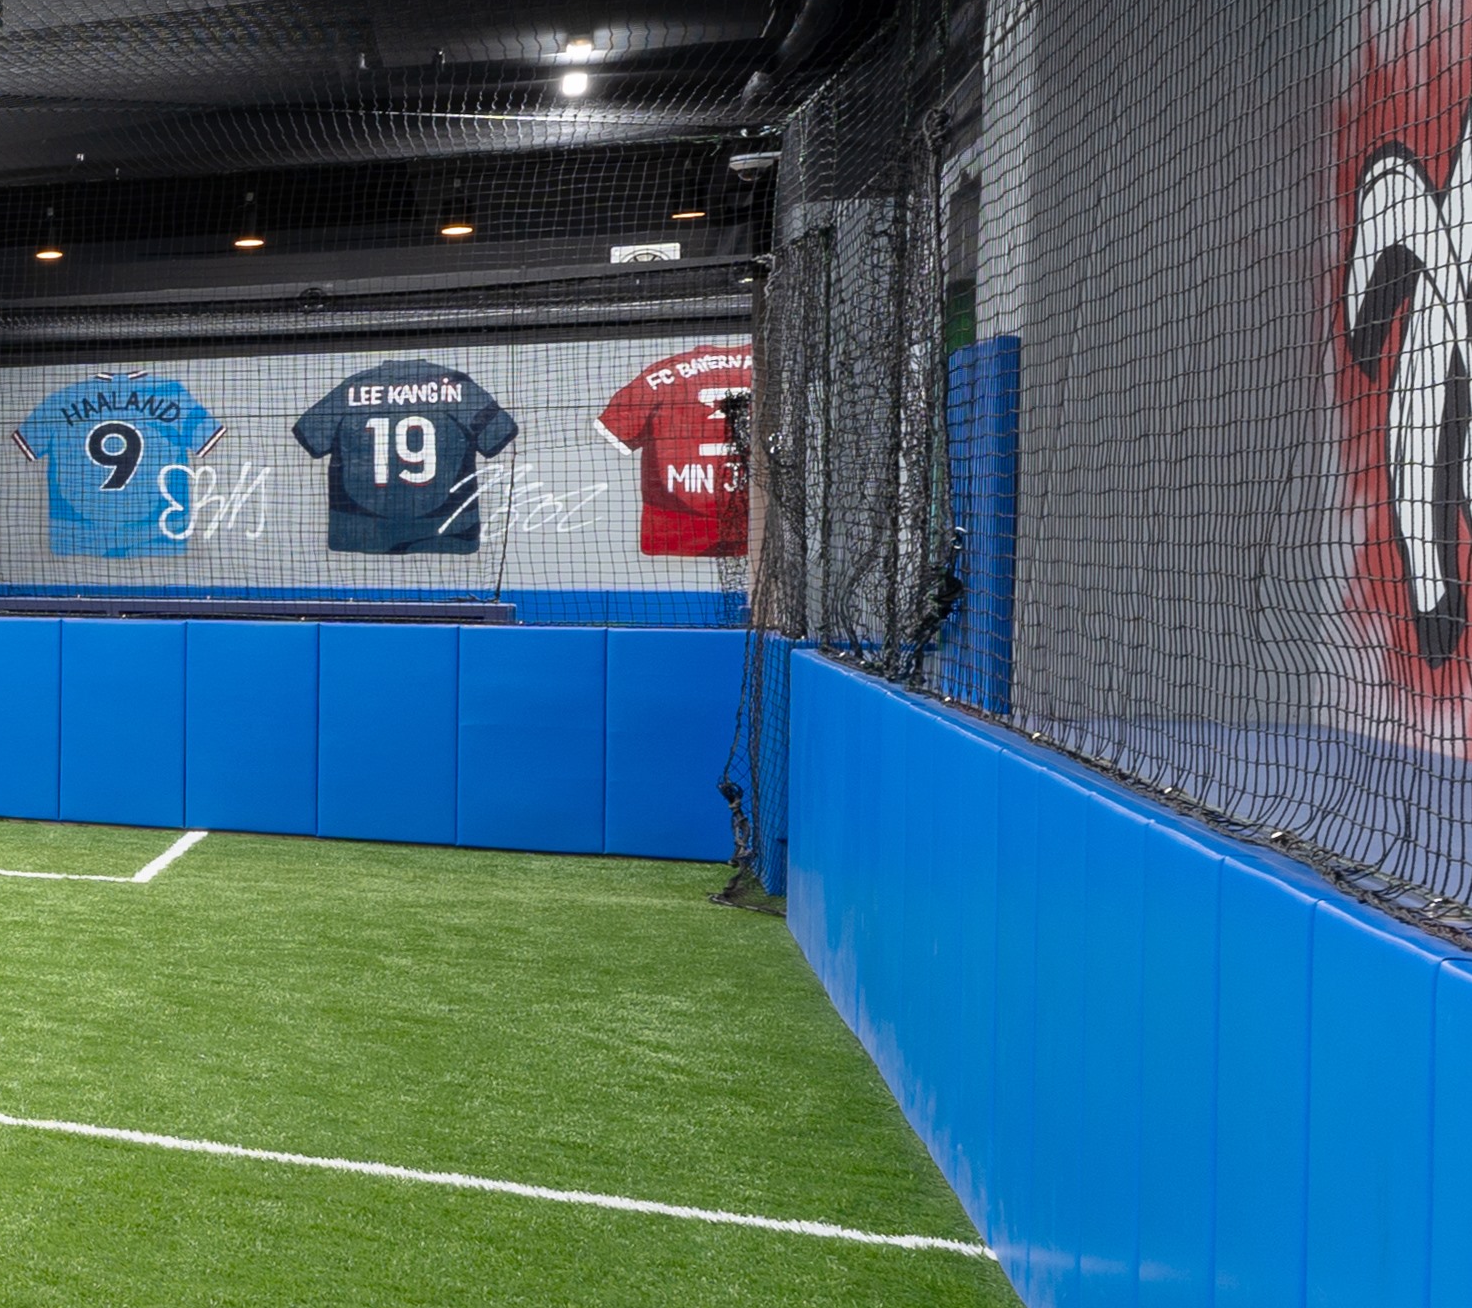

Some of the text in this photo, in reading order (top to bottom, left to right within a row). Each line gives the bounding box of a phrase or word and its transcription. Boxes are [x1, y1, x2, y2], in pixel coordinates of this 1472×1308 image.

[348, 386, 382, 406] LEE
[646, 369, 675, 390] FC
[60, 391, 181, 427] HAALAND
[86, 420, 144, 492] 9
[365, 416, 436, 488] 19
[667, 463, 714, 494] MIN
